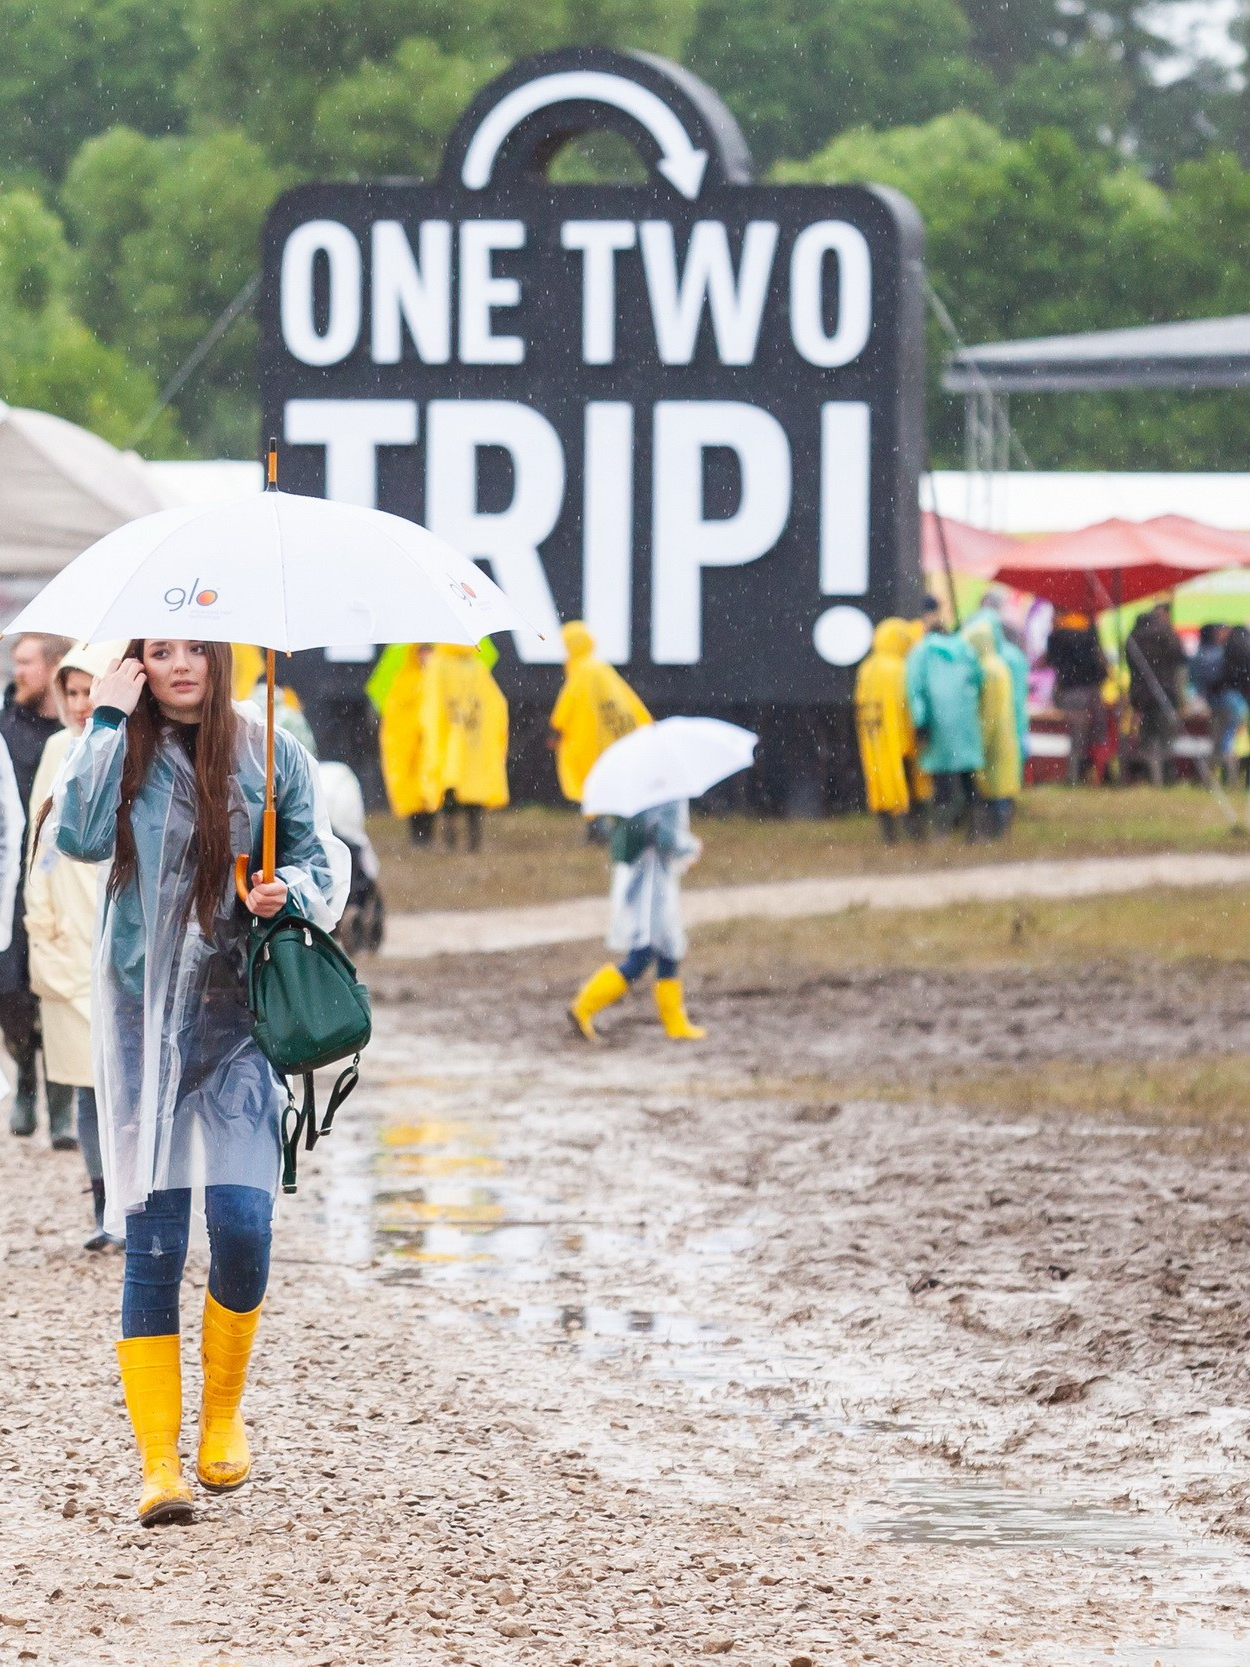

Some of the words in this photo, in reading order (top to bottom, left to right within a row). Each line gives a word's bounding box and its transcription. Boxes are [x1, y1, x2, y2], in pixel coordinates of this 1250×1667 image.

[280, 219, 527, 367] ONE
[561, 219, 873, 368] TWO
[164, 577, 218, 612] glo
[284, 399, 874, 667] TRIP!
